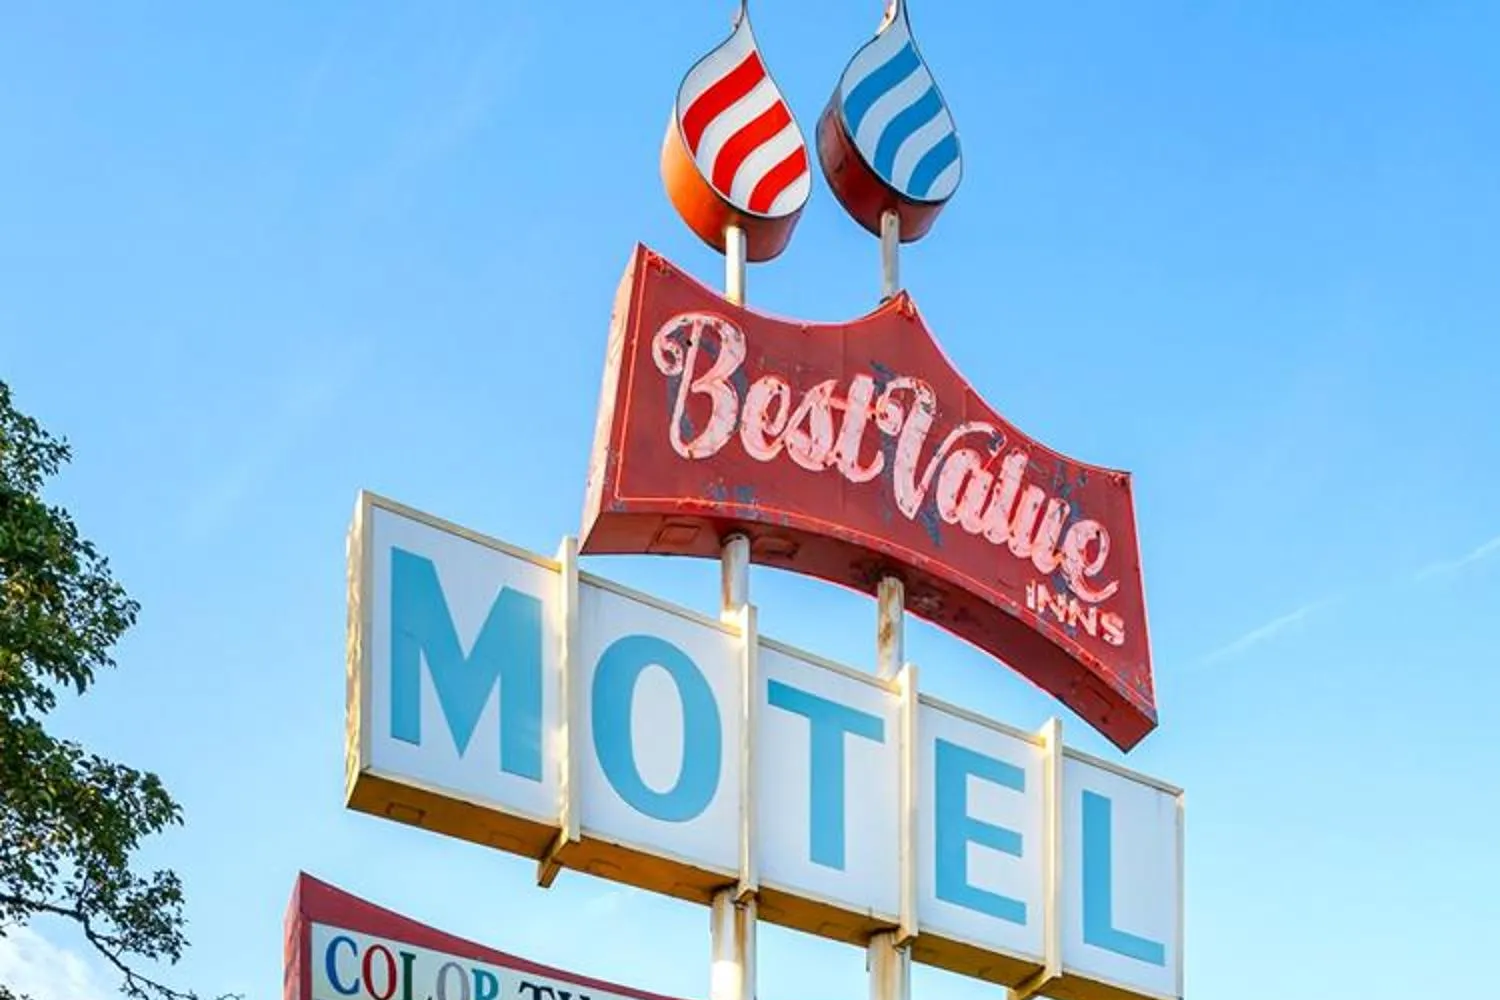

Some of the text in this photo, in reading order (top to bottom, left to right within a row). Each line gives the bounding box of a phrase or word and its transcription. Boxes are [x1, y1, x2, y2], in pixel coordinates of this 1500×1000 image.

[652, 312, 1120, 603] Best Value
[390, 546, 1166, 967] MOTEL
[1025, 580, 1125, 647] INNS
